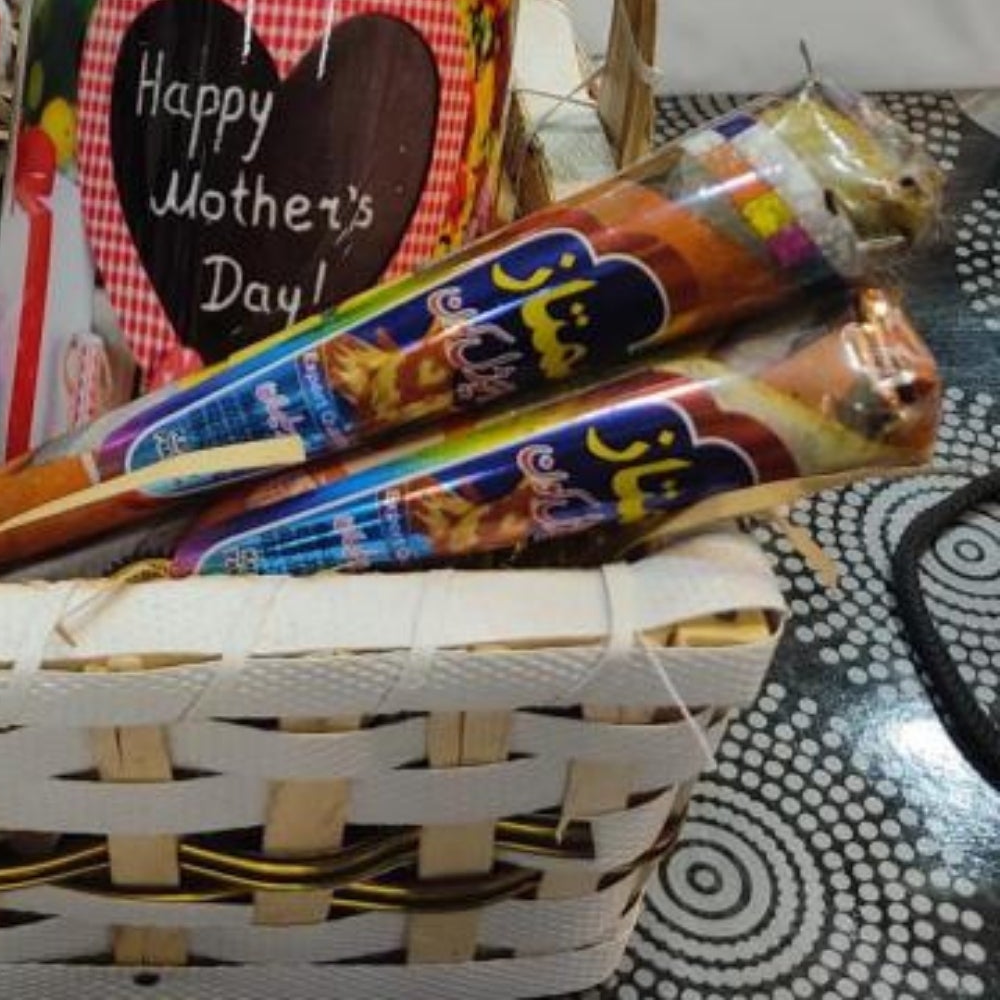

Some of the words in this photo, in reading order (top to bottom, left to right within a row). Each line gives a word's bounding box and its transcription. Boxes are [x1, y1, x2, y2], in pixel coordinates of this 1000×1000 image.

[135, 49, 274, 163] Happy
[150, 169, 374, 232] Mother's
[200, 254, 327, 330] Day!
